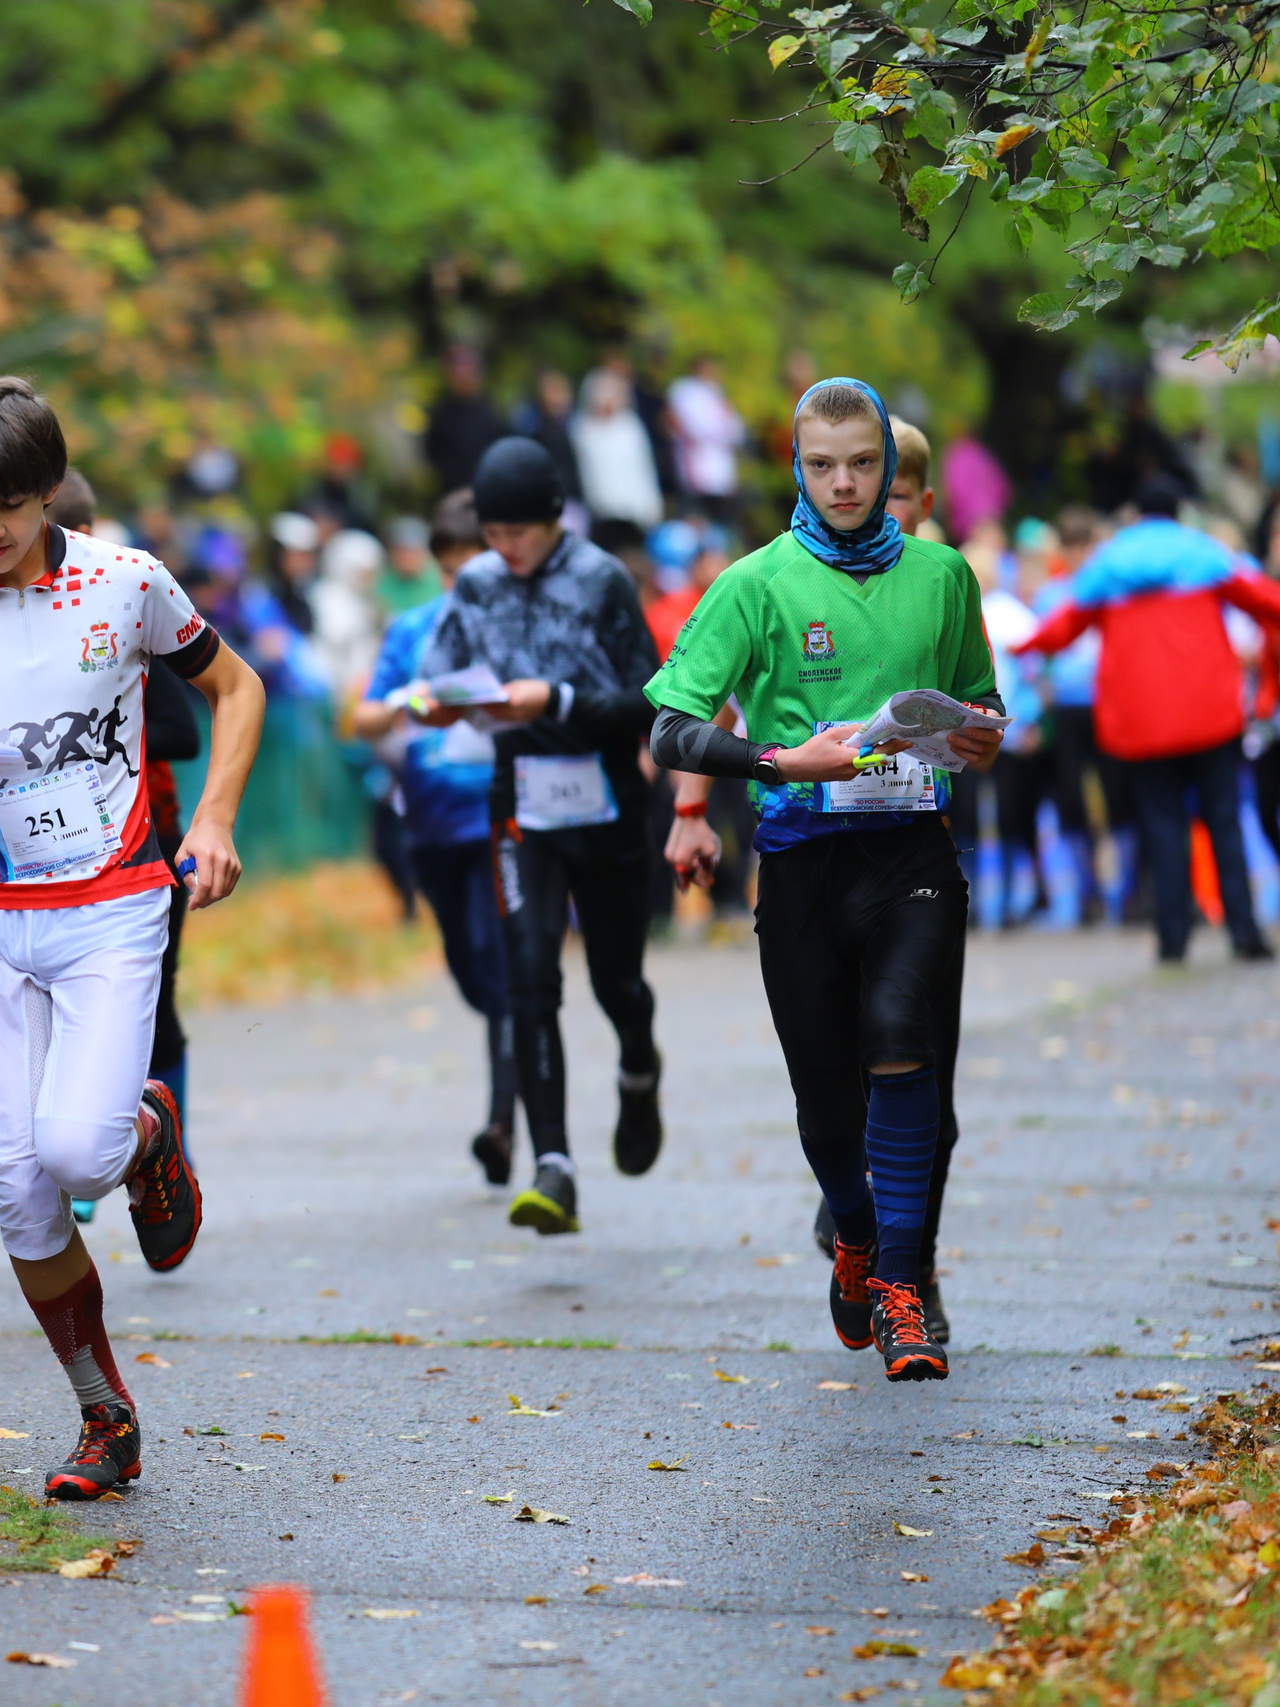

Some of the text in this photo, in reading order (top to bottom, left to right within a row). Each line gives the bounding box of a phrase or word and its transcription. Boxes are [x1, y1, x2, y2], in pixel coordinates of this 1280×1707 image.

[798, 667, 842, 677] СМОЛЕНСКОЕ
[881, 779, 886, 788] 3
[887, 779, 913, 787] линия
[24, 807, 68, 837] 251
[51, 827, 89, 843] 3 линия
